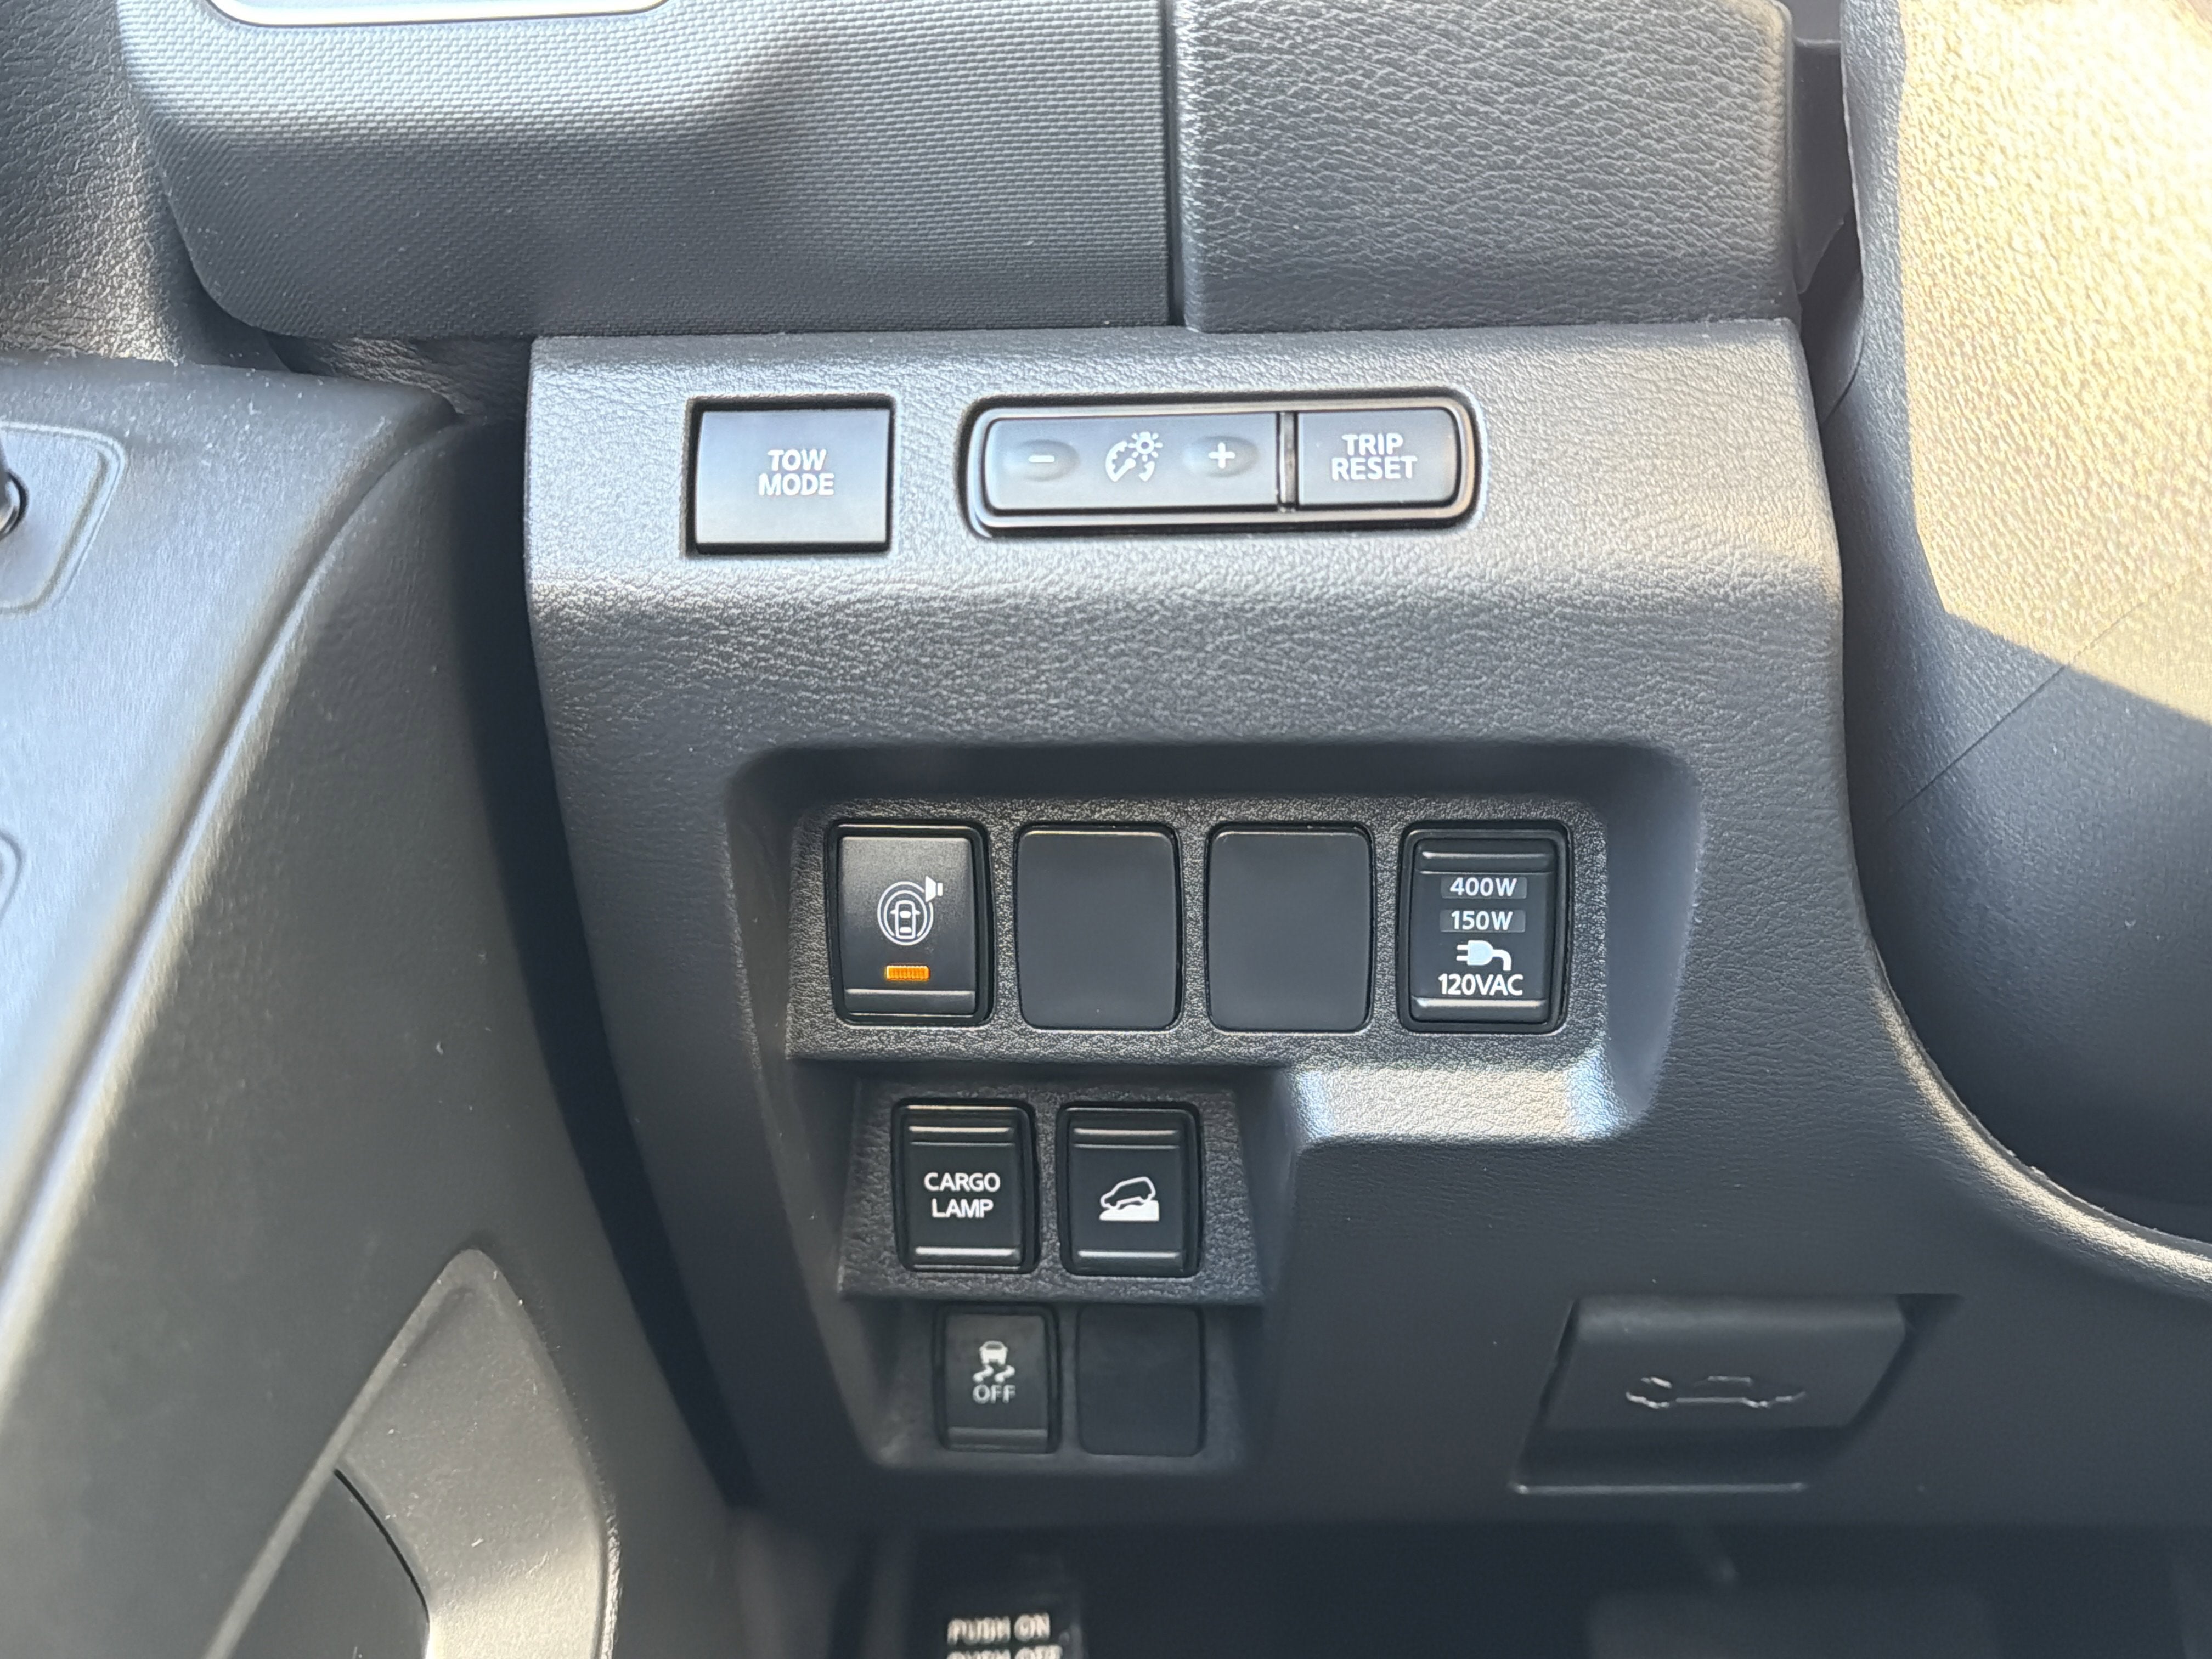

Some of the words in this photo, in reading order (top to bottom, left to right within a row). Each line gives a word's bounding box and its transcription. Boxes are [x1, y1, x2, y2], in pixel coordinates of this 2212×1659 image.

[1341, 432, 1403, 456] TRIP
[768, 448, 827, 471] TOW
[1331, 455, 1418, 481] RESET
[758, 473, 834, 496] MODE
[1449, 877, 1517, 897] 400W
[1451, 910, 1513, 931] 150W
[1438, 973, 1524, 996] 120VAC
[924, 1172, 1001, 1192] CARGO
[932, 1198, 994, 1218] LAMP
[972, 1384, 1016, 1403] OFF
[1014, 1612, 1051, 1642] ON
